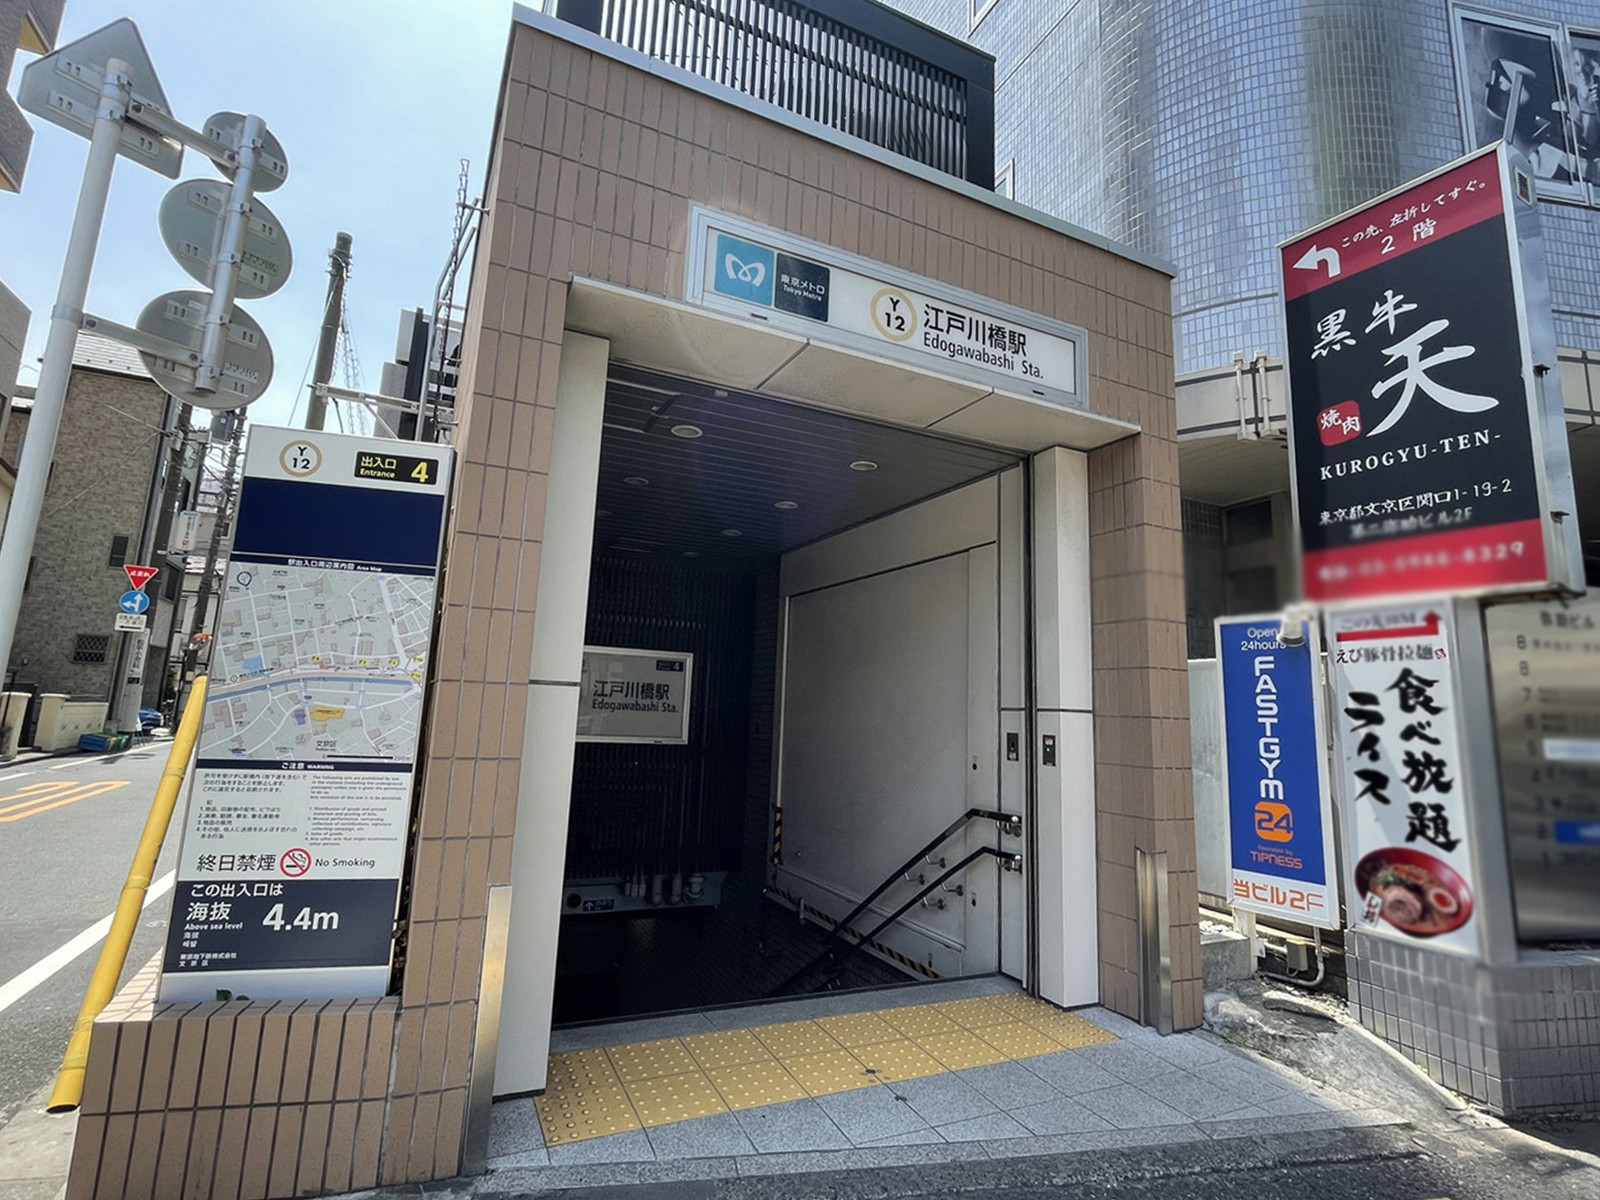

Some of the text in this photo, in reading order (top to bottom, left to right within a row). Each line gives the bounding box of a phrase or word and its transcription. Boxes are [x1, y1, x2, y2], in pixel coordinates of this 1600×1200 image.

[1342, 180, 1486, 248] この先、左折してすぐ。
[780, 274, 825, 295] 東京メトロ
[783, 284, 822, 301] Tokyo Metro
[889, 297, 900, 312] Y
[885, 312, 906, 331] 12
[924, 304, 1027, 357] 江戸川橋駅
[924, 333, 1044, 379] Edogawabashi Sta.
[1366, 319, 1499, 437] 天
[1320, 410, 1361, 435] 焼肉
[298, 446, 307, 456] Y
[292, 458, 310, 469] 12
[361, 456, 396, 469] 出入口
[411, 462, 428, 482] 4
[360, 468, 395, 478] Entrance
[288, 558, 355, 570] 駅出入口周辺案内図
[1247, 627, 1278, 639] Open
[1241, 640, 1287, 651] 24hours
[593, 680, 670, 700] 江戸川橋駅
[592, 699, 679, 713] Edogawabashi Sta.
[1344, 691, 1391, 806] ライス
[1385, 667, 1462, 853] 食べ放題
[1255, 808, 1293, 834] 24
[197, 854, 376, 872] 終日禁煙 No Smoking
[191, 883, 283, 898] この出入口は
[1234, 879, 1324, 912] 当ビル2F
[186, 902, 339, 931] 海抜 4.4m
[184, 923, 209, 931] Above
[225, 922, 243, 930] level
